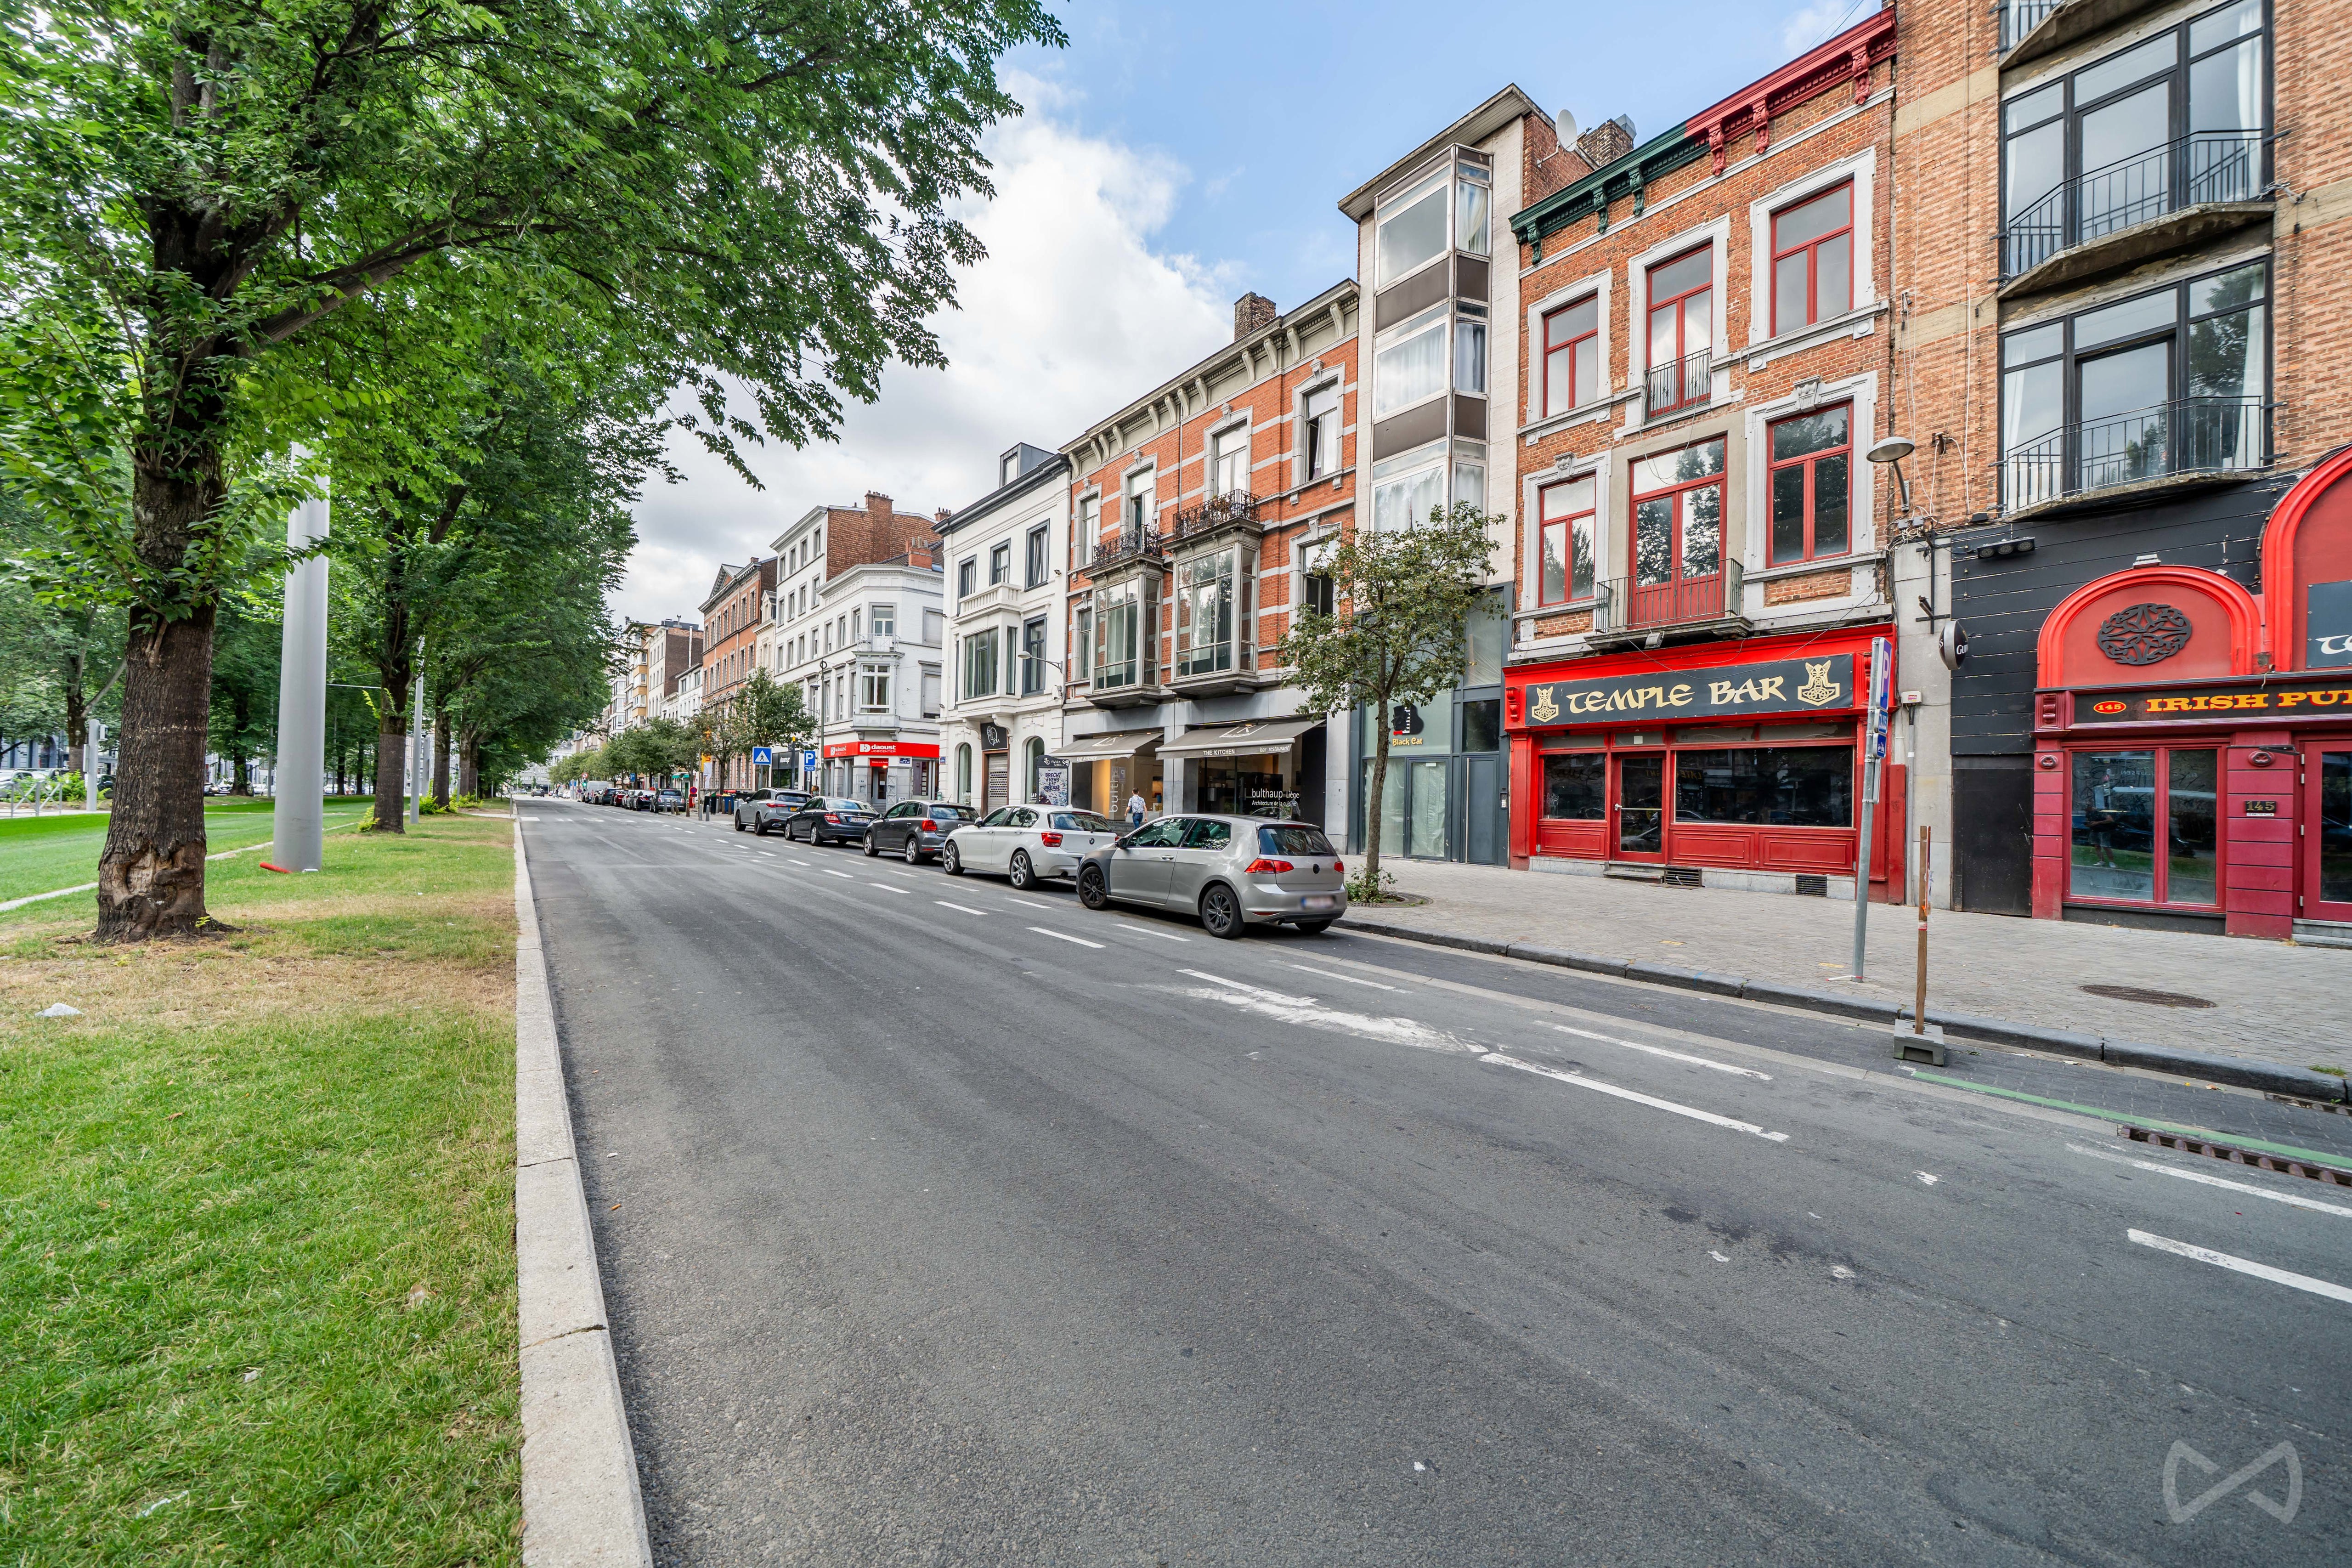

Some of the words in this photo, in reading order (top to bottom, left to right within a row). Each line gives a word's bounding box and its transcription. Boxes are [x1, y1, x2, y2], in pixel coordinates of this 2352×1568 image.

[1881, 651, 1889, 697] P
[1566, 684, 1695, 713] TEMPLE
[1708, 676, 1787, 705] BAR
[2146, 694, 2268, 713] IRISH
[1879, 713, 1887, 730] TAXIS
[1392, 738, 1409, 747] Black
[806, 753, 814, 764] P
[1252, 788, 1283, 800] bulthaup
[1286, 791, 1299, 799] Liège
[2246, 801, 2275, 811] 145
